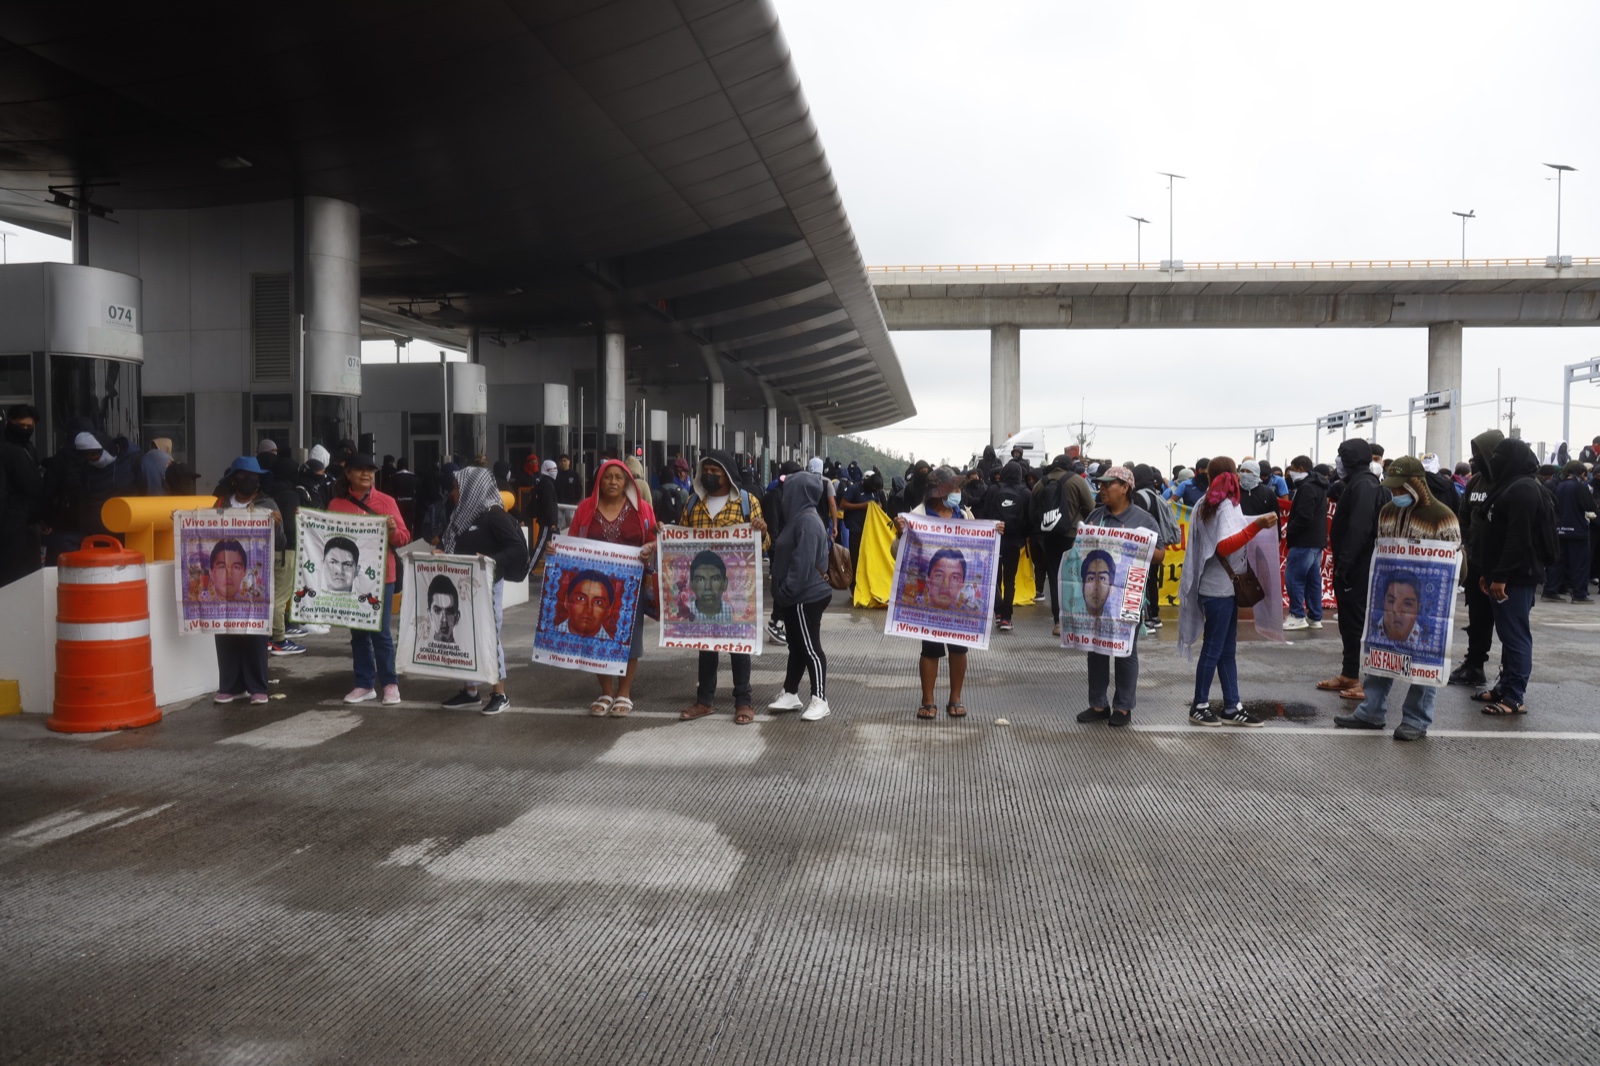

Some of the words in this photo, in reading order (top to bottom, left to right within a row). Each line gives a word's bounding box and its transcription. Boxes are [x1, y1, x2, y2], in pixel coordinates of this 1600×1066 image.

[108, 305, 132, 322] 074
[182, 518, 205, 529] ¡Vivo
[220, 518, 229, 527] lo
[231, 518, 270, 527] llevaron!
[306, 522, 326, 530] ¡Vivo
[345, 526, 379, 534] llevaron!
[908, 520, 928, 531] Vivo
[931, 525, 941, 533] se
[944, 525, 953, 534] lo
[955, 525, 995, 538] llevaron!
[662, 528, 689, 541] ¡Nos
[732, 528, 753, 539] 43!
[1085, 528, 1095, 536] se
[1097, 527, 1106, 536] lo
[1108, 528, 1150, 545] llevaron!
[579, 547, 593, 555] vivo
[1388, 545, 1396, 554] se
[1396, 544, 1406, 554] lo
[1408, 545, 1456, 559] llevaron!
[303, 559, 315, 574] 43
[365, 566, 376, 580] 43
[437, 564, 443, 572] lo
[443, 564, 470, 576] llevaron!
[1128, 565, 1147, 584] NOS
[339, 609, 371, 618] queremos!
[212, 620, 220, 628] lo
[896, 622, 919, 633] ¡Vivo
[921, 626, 930, 635] lo
[931, 629, 979, 642] queremos!
[1081, 635, 1090, 644] lo
[427, 654, 441, 662] VIDA
[549, 654, 566, 662] ¡Vivo
[575, 659, 608, 669] queremos!
[1370, 650, 1382, 668] NOS
[1410, 668, 1439, 679] remos!
